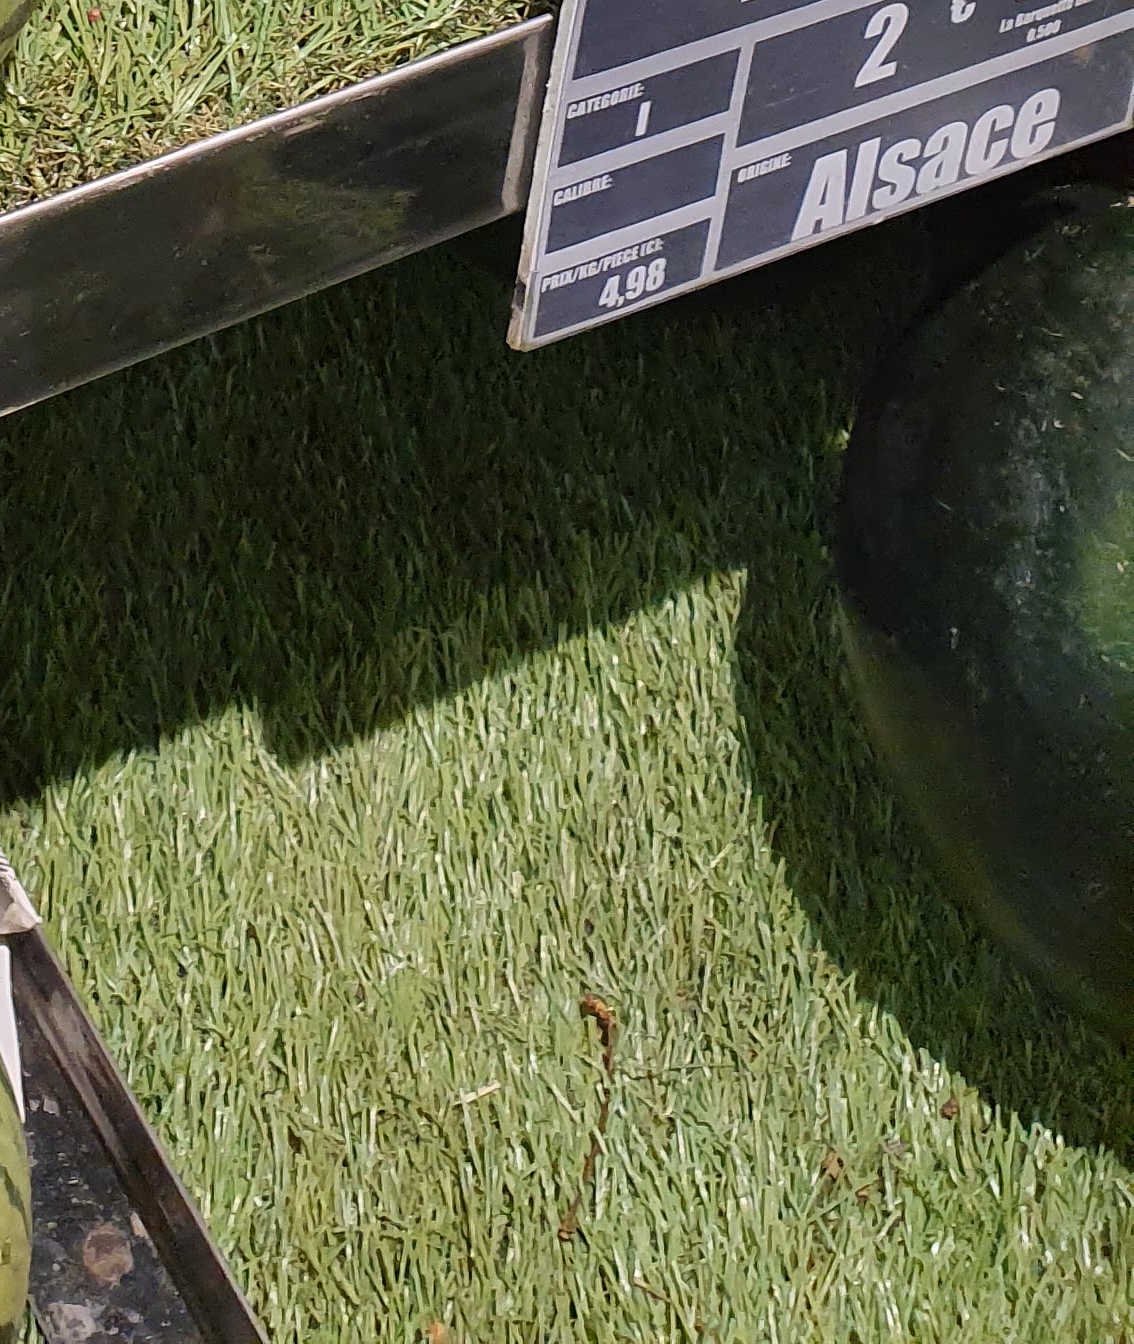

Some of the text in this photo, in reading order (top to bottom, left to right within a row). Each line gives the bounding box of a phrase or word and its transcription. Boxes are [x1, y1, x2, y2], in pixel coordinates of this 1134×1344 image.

[854, 2, 910, 88] 2
[790, 87, 1062, 242] Alsace
[598, 258, 667, 308] 4,98
